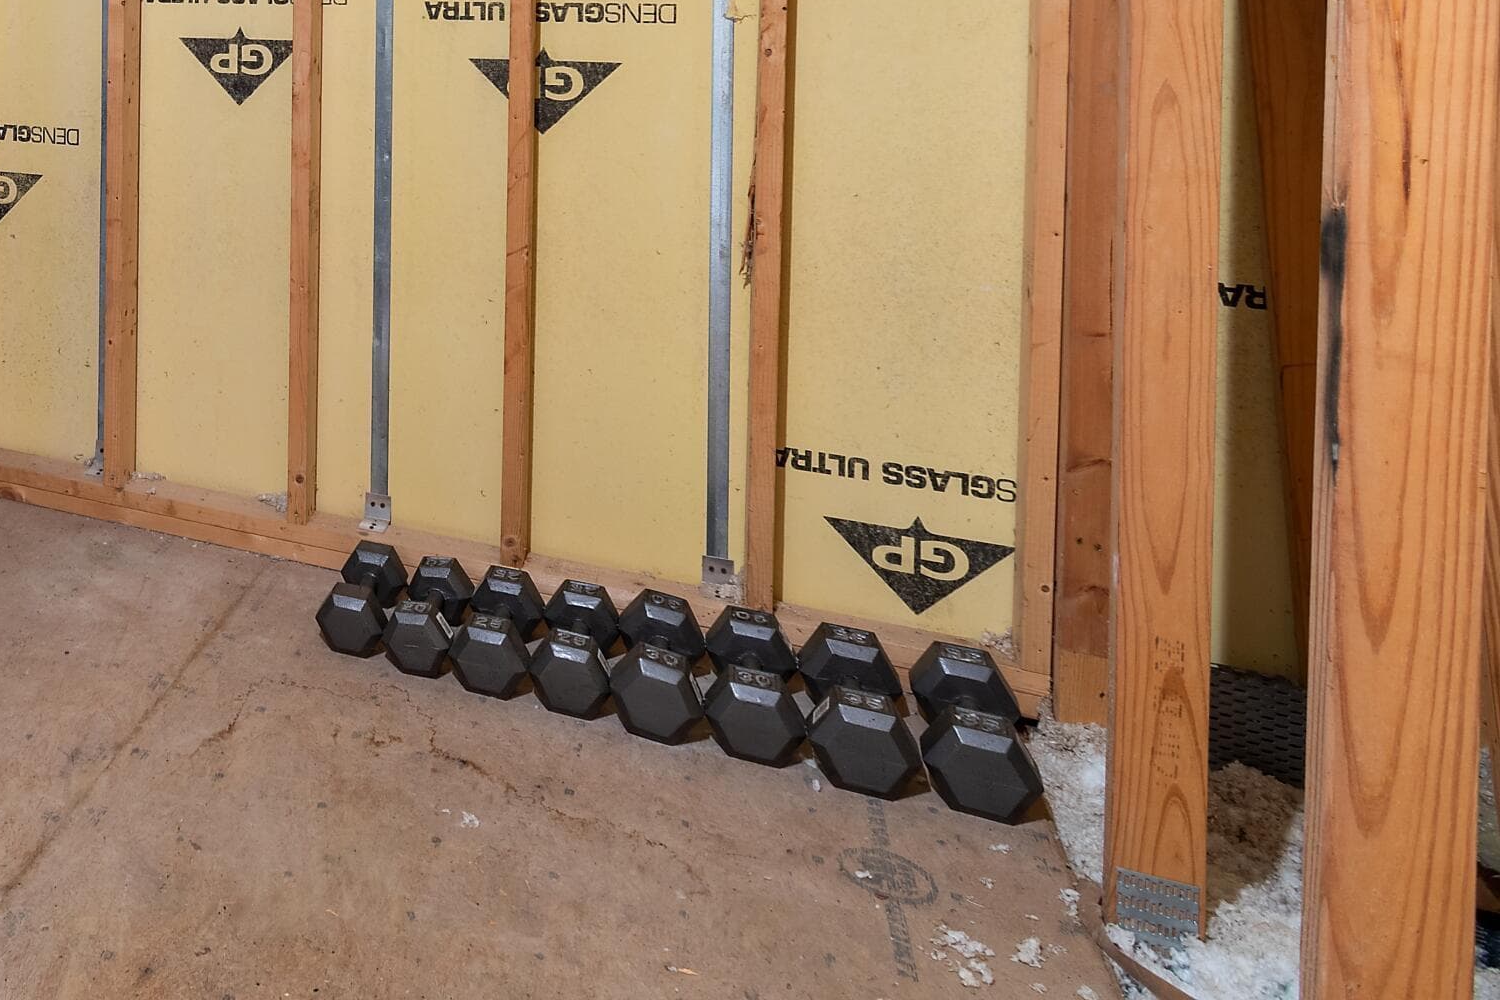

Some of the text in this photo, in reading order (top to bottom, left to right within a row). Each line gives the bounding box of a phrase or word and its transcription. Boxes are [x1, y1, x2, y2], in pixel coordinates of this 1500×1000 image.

[425, 1, 506, 21] ULTRA
[210, 44, 273, 76] GP
[775, 446, 870, 481] ULTRA
[872, 536, 970, 582] GP
[645, 648, 679, 666] 30
[737, 670, 773, 688] 30
